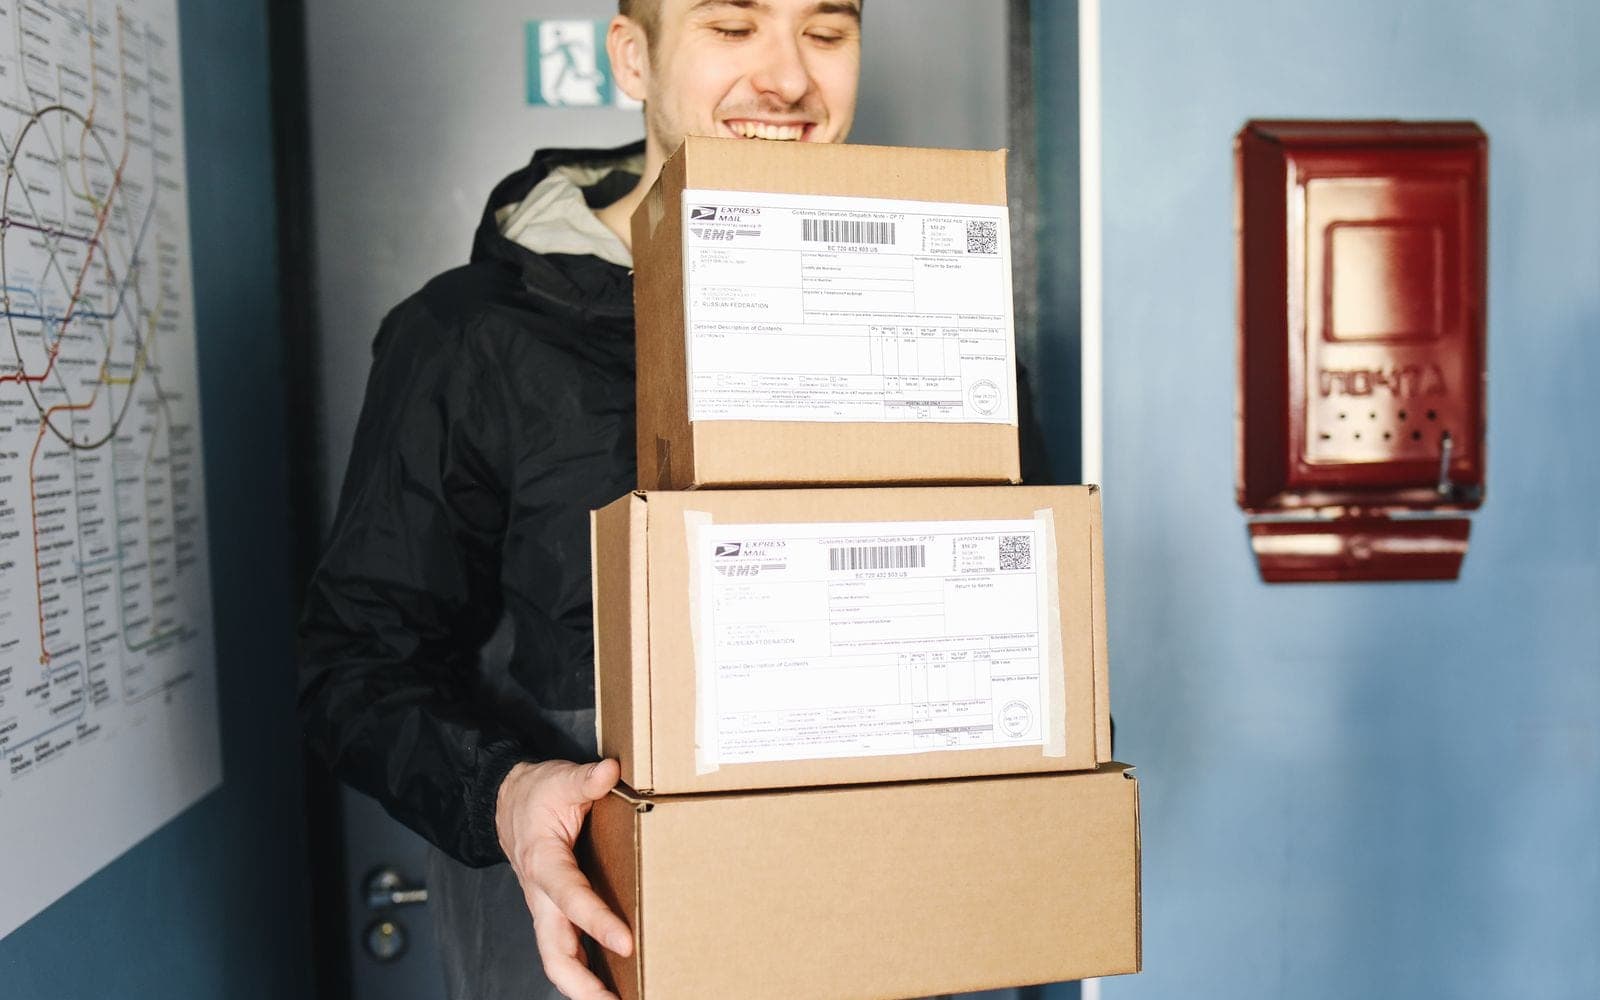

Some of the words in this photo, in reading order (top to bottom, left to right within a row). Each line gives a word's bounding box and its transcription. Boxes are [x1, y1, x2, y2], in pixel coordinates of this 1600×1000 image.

[720, 206, 761, 215] EXPRESS
[719, 215, 742, 223] MAIL
[702, 228, 735, 241] EMS
[1319, 367, 1448, 398] ПОЧТА
[727, 564, 760, 577] EMS
